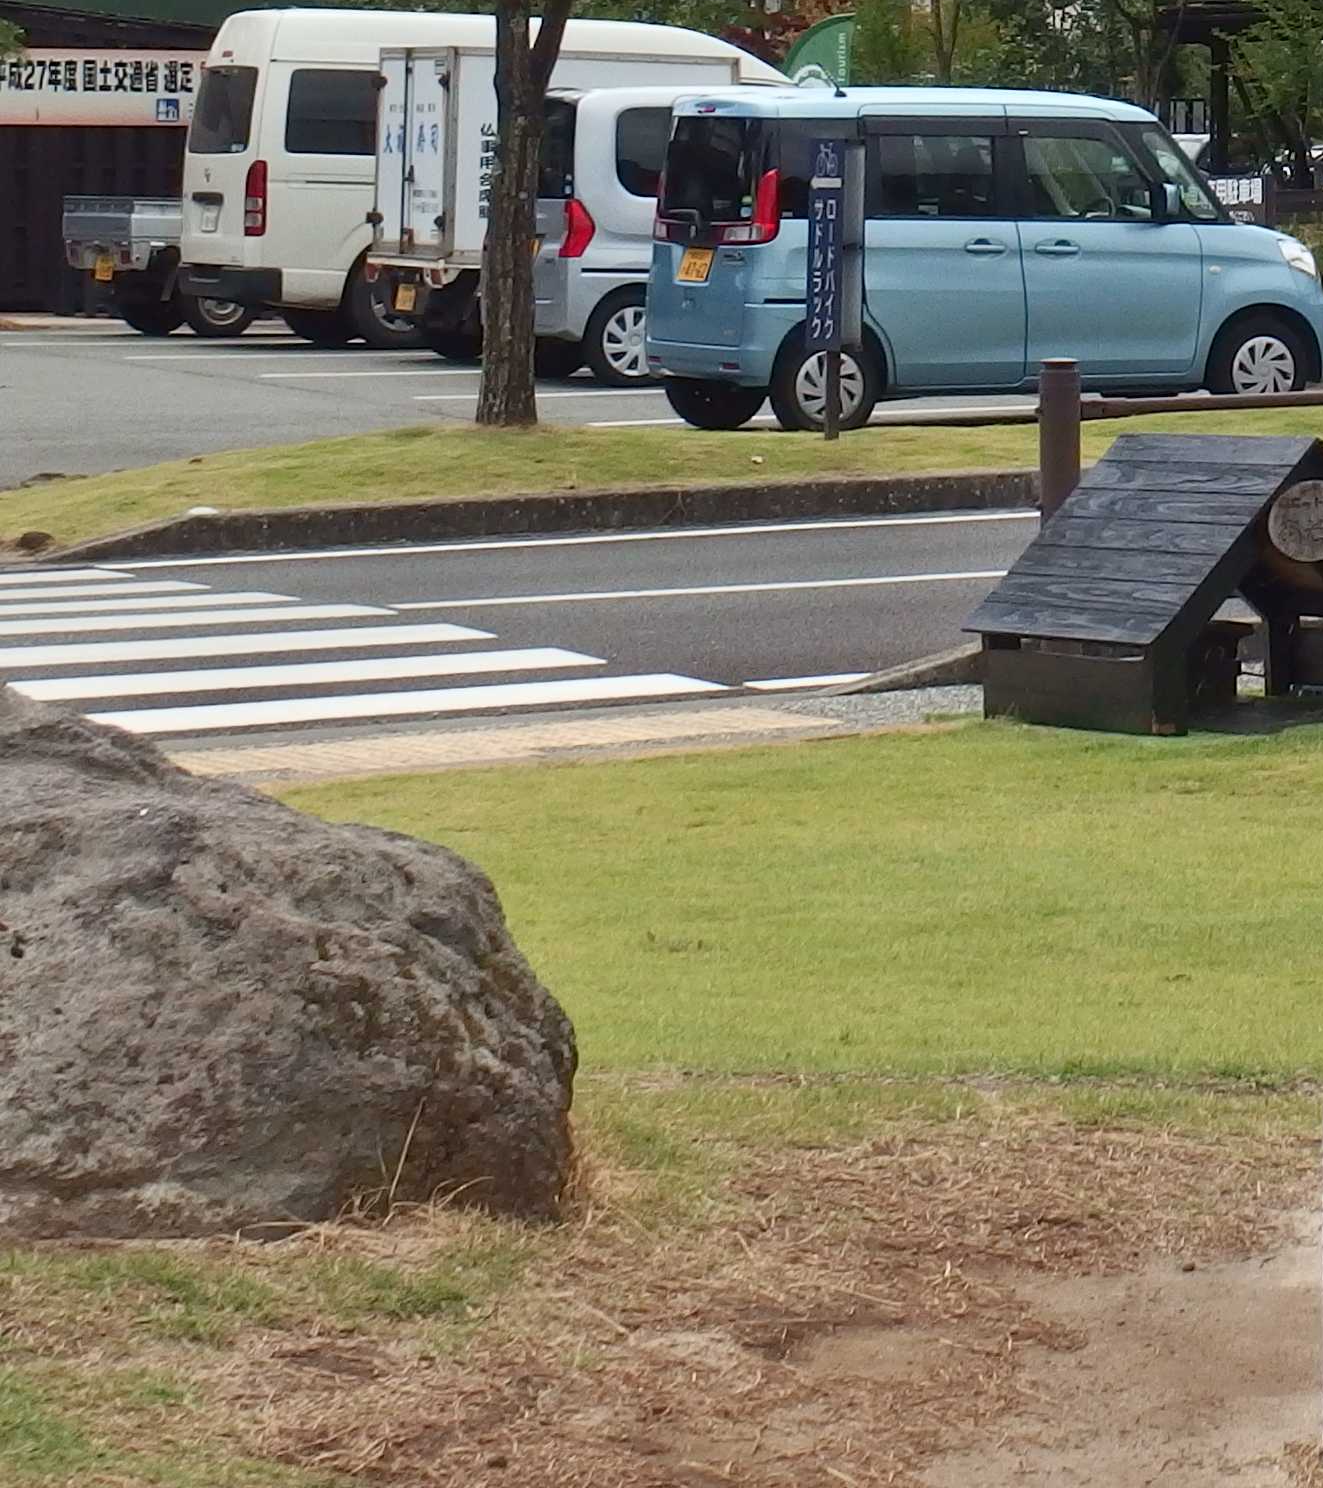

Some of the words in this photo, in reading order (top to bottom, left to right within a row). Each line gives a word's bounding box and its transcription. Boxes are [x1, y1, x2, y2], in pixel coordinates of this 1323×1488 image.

[823, 199, 837, 340] ロードバイク
